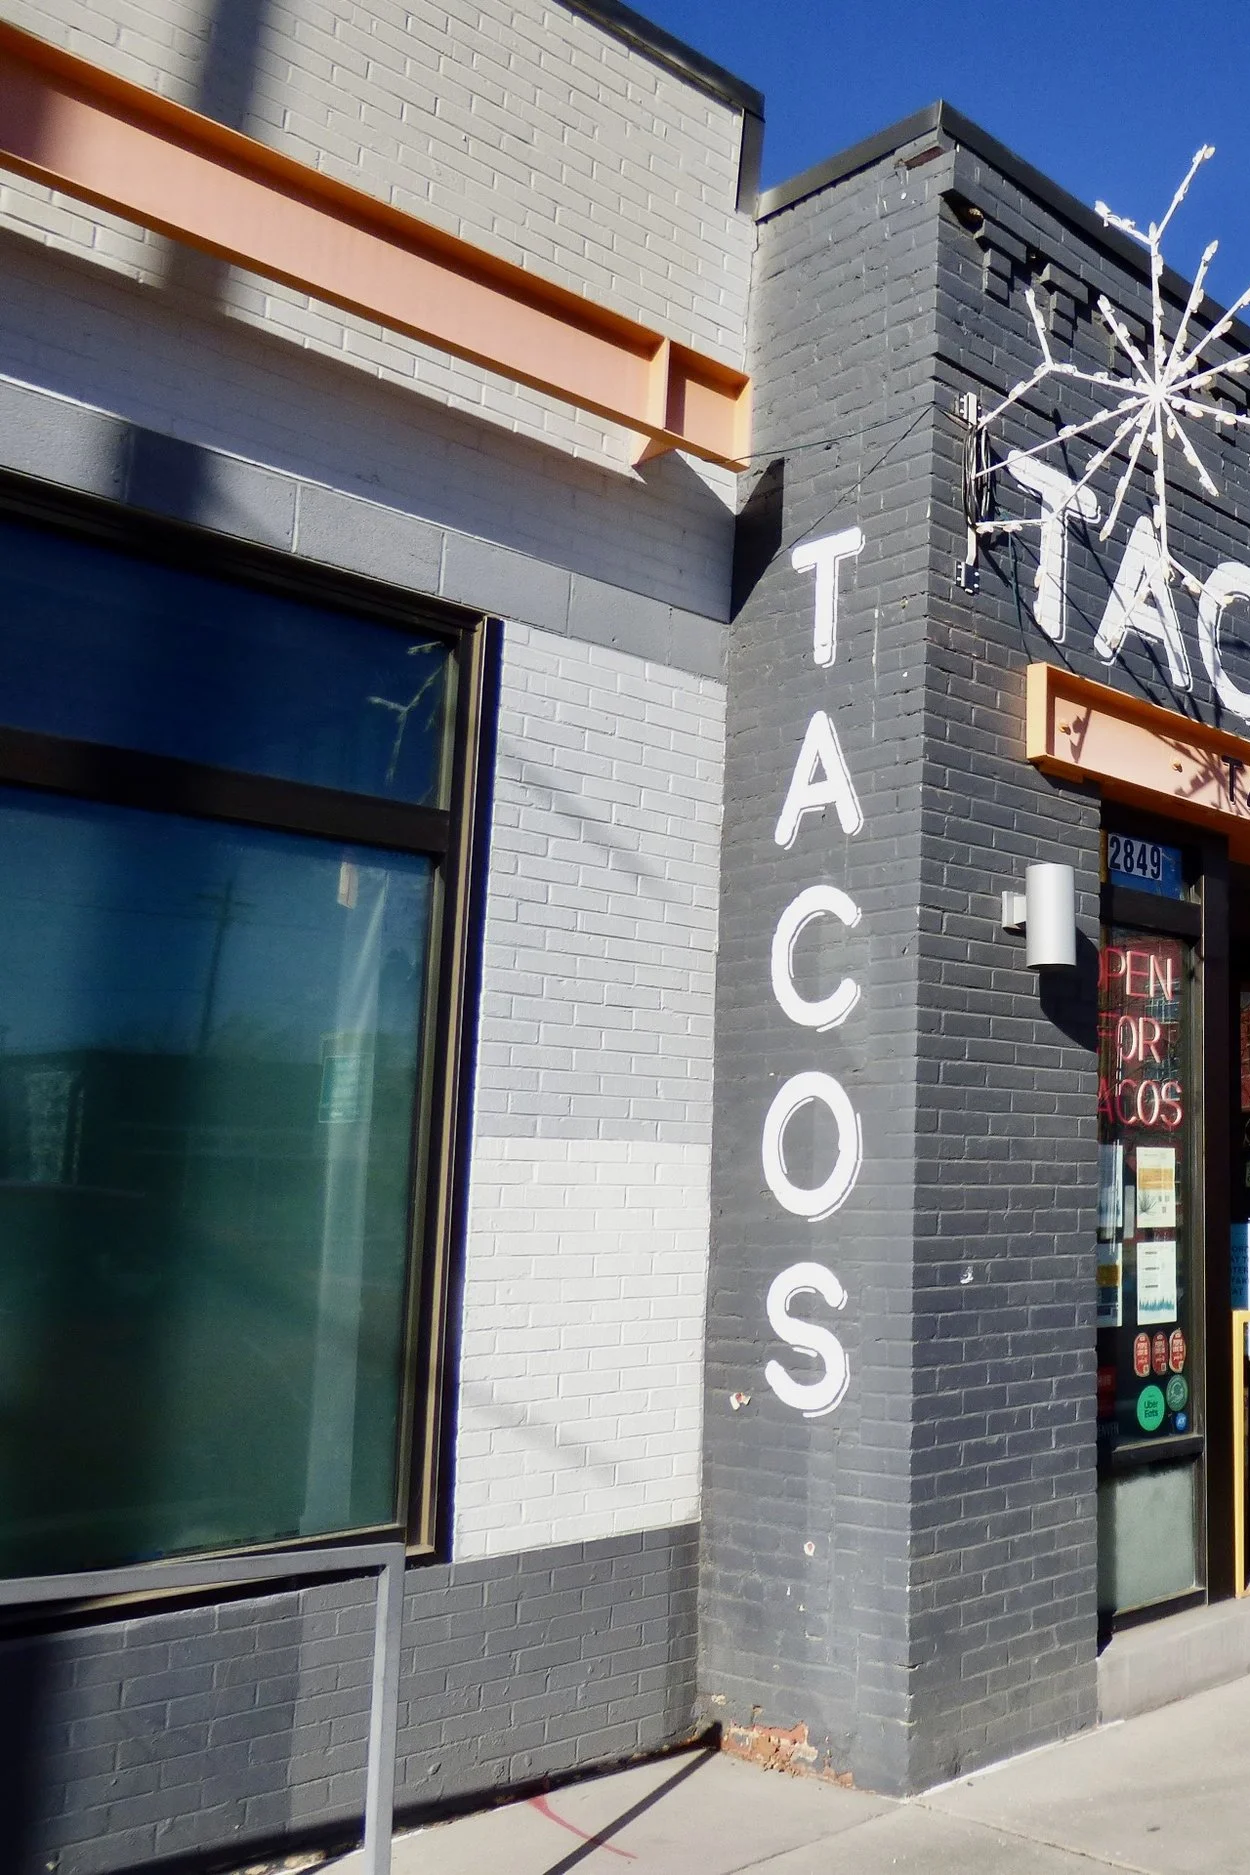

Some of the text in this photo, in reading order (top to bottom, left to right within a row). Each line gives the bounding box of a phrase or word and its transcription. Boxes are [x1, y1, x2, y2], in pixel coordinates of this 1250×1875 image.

[1108, 835, 1162, 880] 2849
[762, 526, 865, 1419] TACOS
[1143, 1400, 1159, 1409] Uber
[1144, 1409, 1159, 1418] Eats
